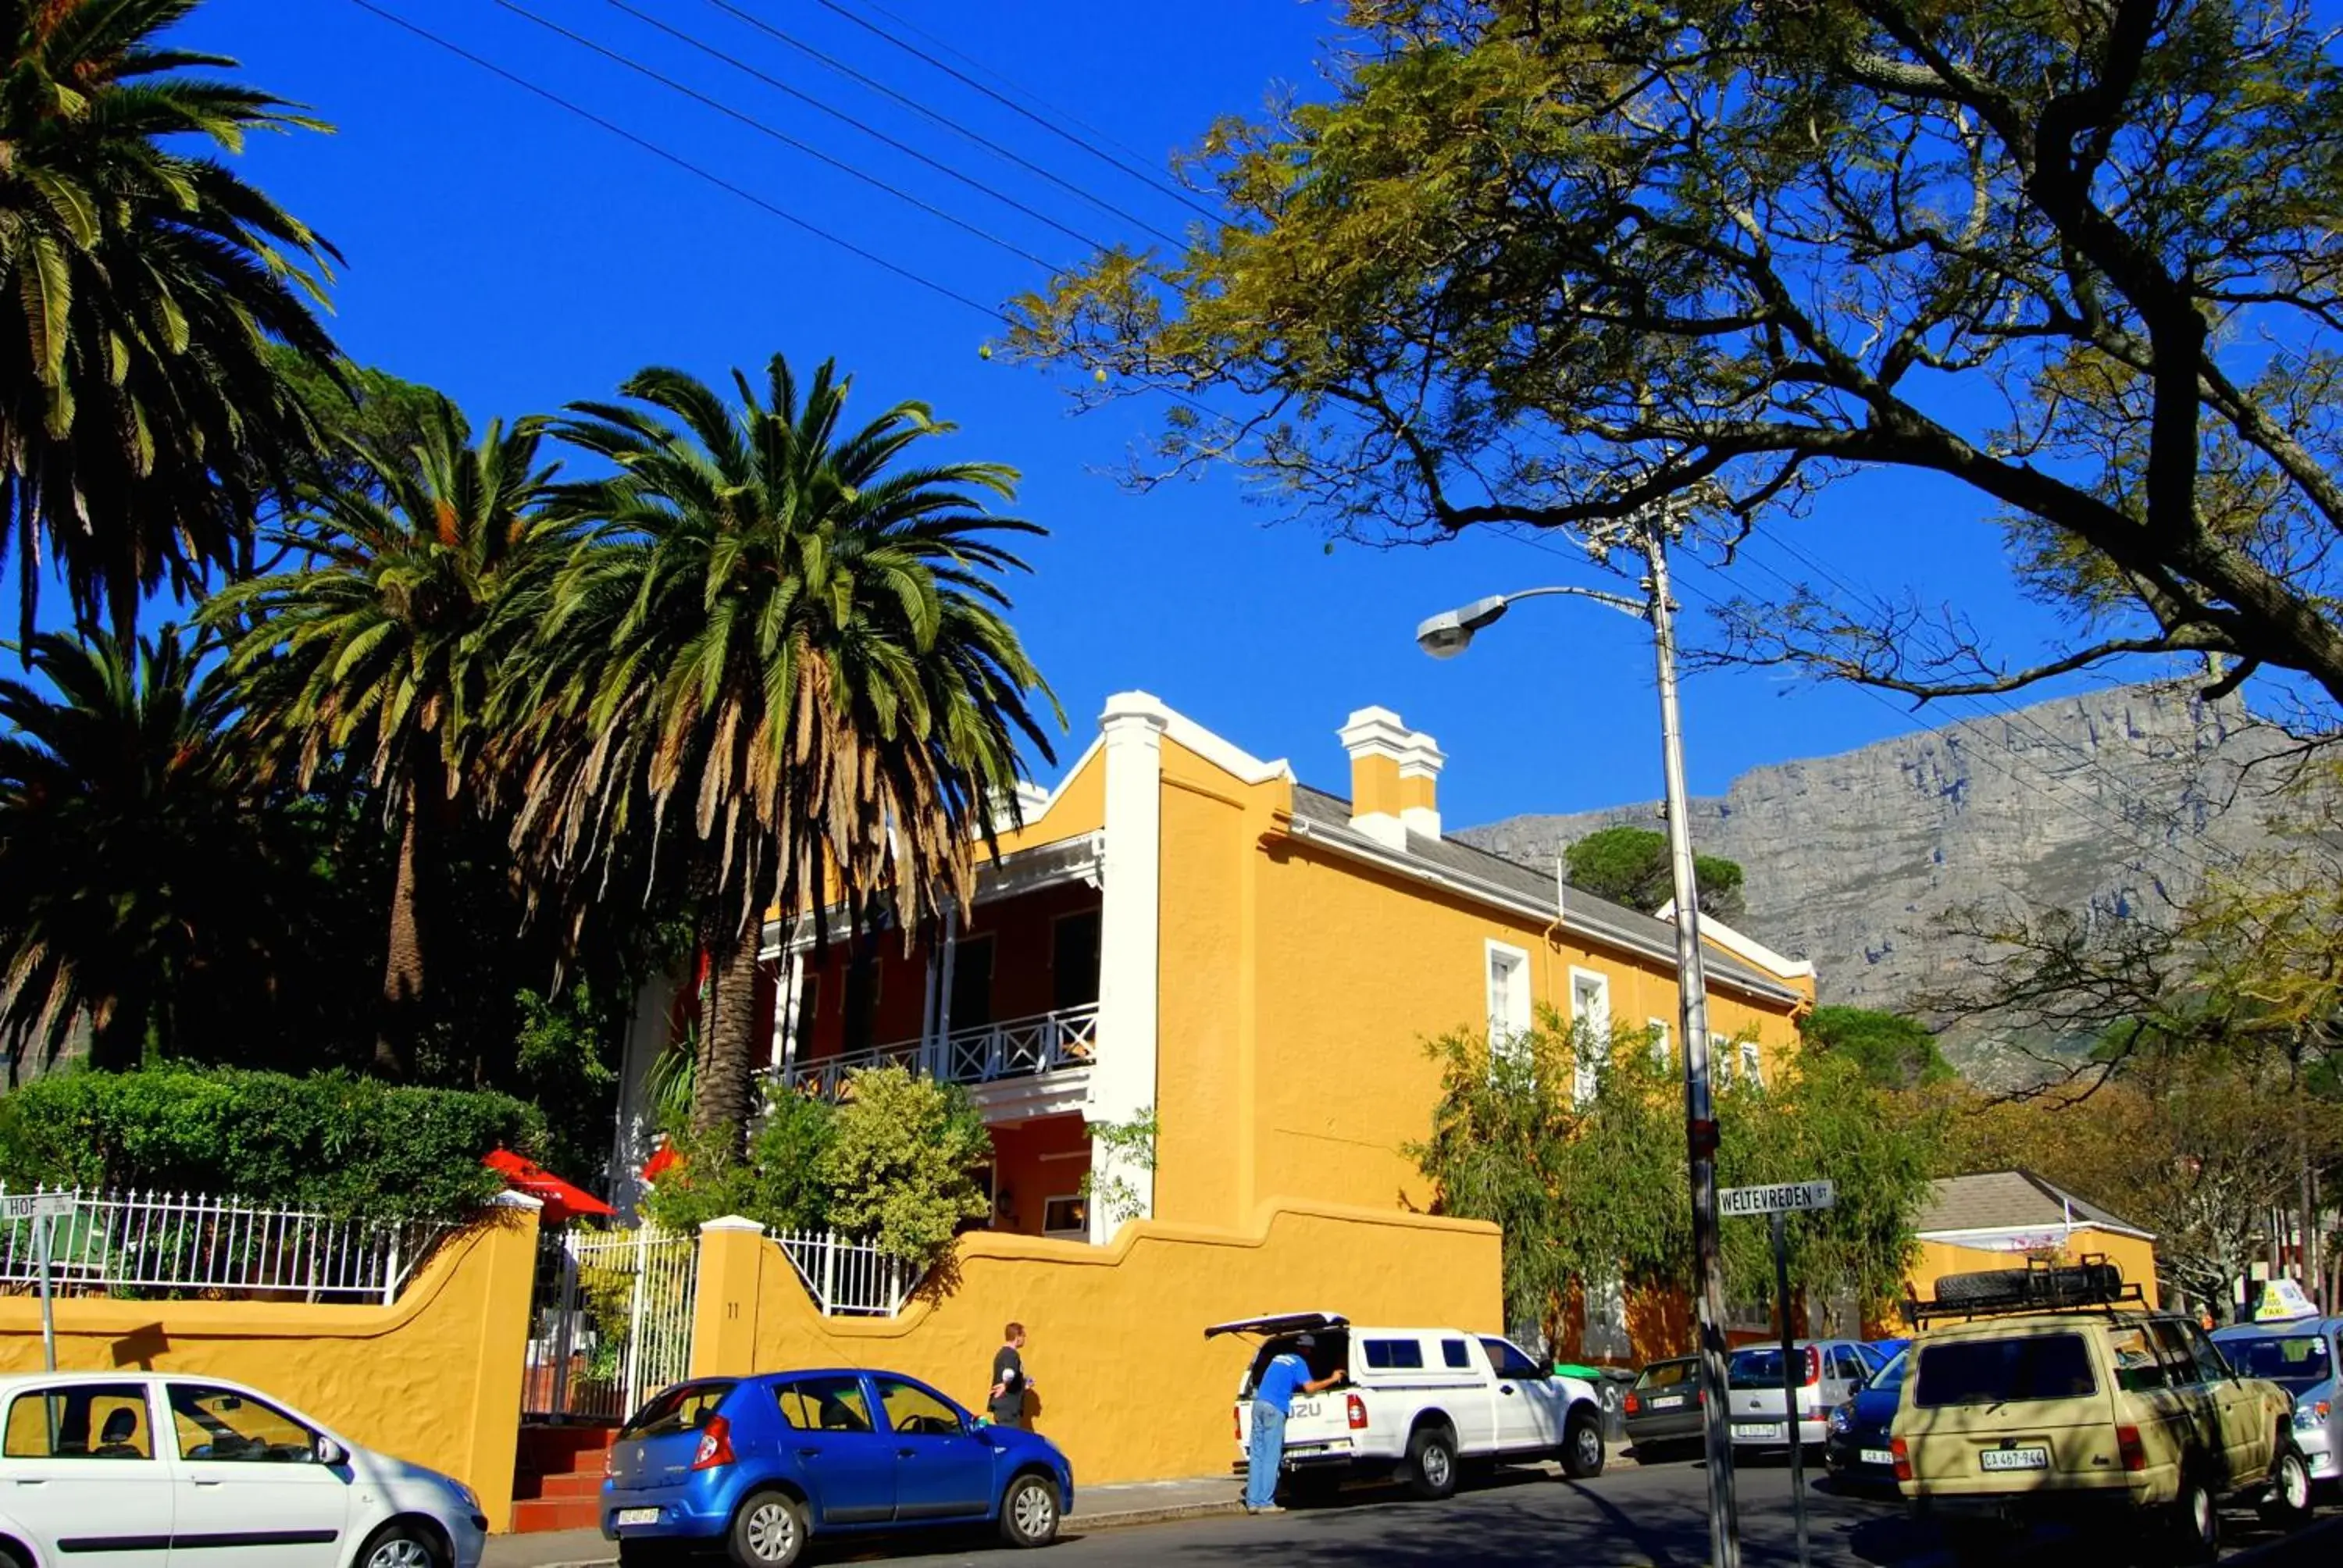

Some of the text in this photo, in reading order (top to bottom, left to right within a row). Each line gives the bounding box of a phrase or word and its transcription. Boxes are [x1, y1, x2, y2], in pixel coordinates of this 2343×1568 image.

[1721, 1186, 1827, 1212] WELTEVREDEN ST
[727, 1302, 738, 1319] 11
[1985, 1453, 1998, 1466] CA
